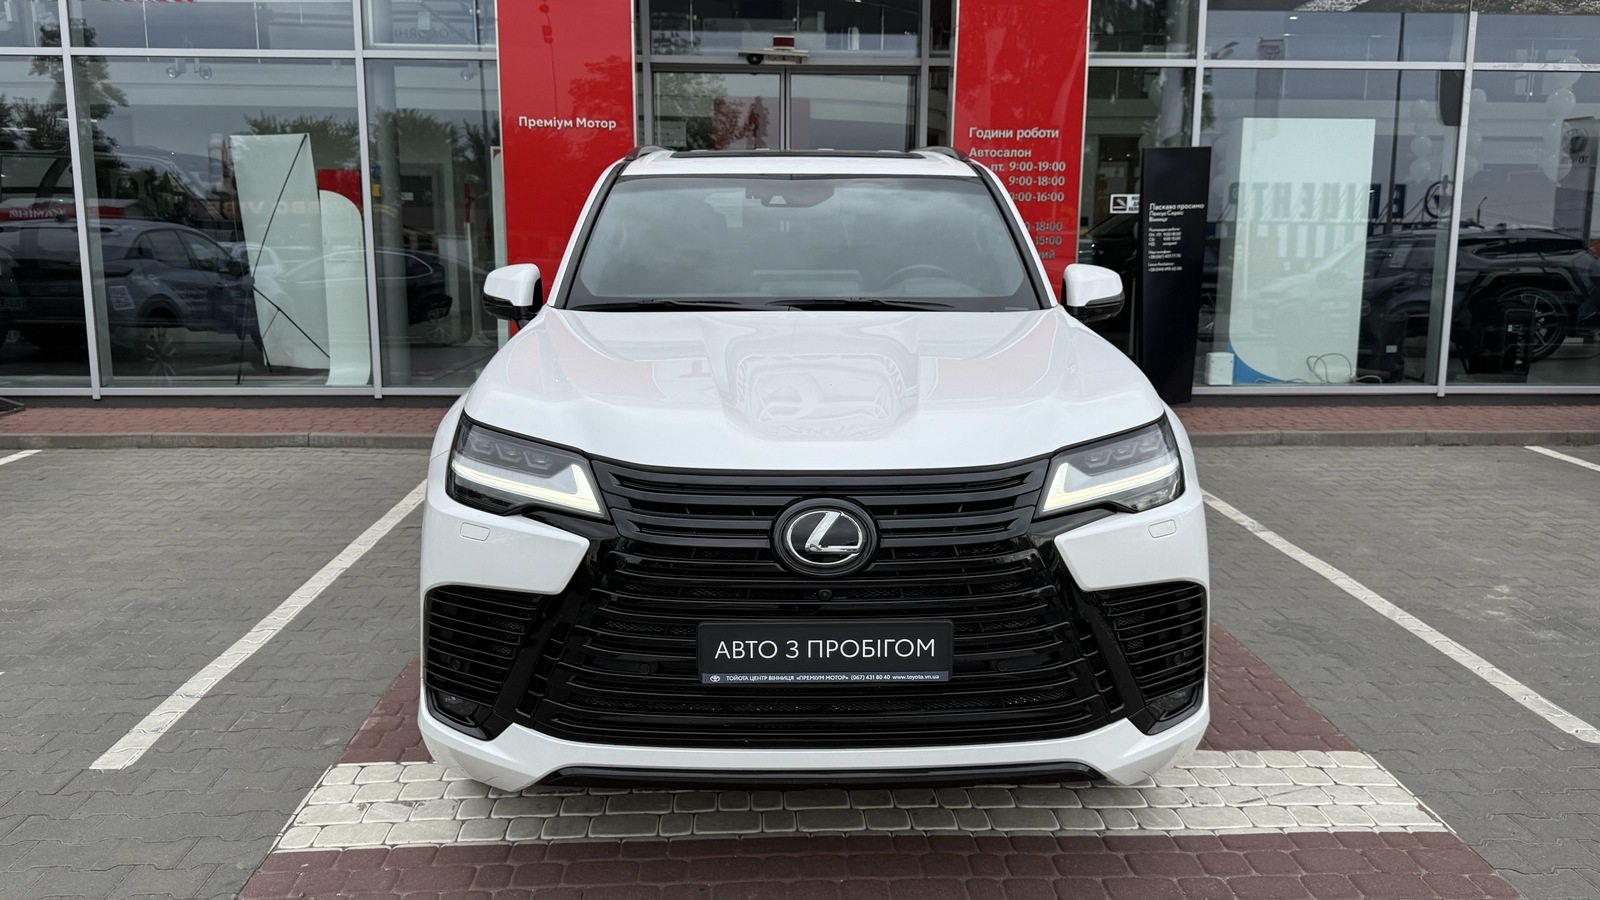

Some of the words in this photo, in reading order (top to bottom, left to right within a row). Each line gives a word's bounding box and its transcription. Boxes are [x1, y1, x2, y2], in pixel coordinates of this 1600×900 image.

[518, 116, 573, 130] Преміум
[575, 117, 617, 131] Мотор
[968, 127, 1013, 140] Години
[1016, 127, 1060, 141] роботи
[968, 147, 1032, 158] Автосалон
[714, 640, 778, 659] АВТО
[785, 640, 799, 659] З
[807, 638, 935, 658] ПРОБІГОМ
